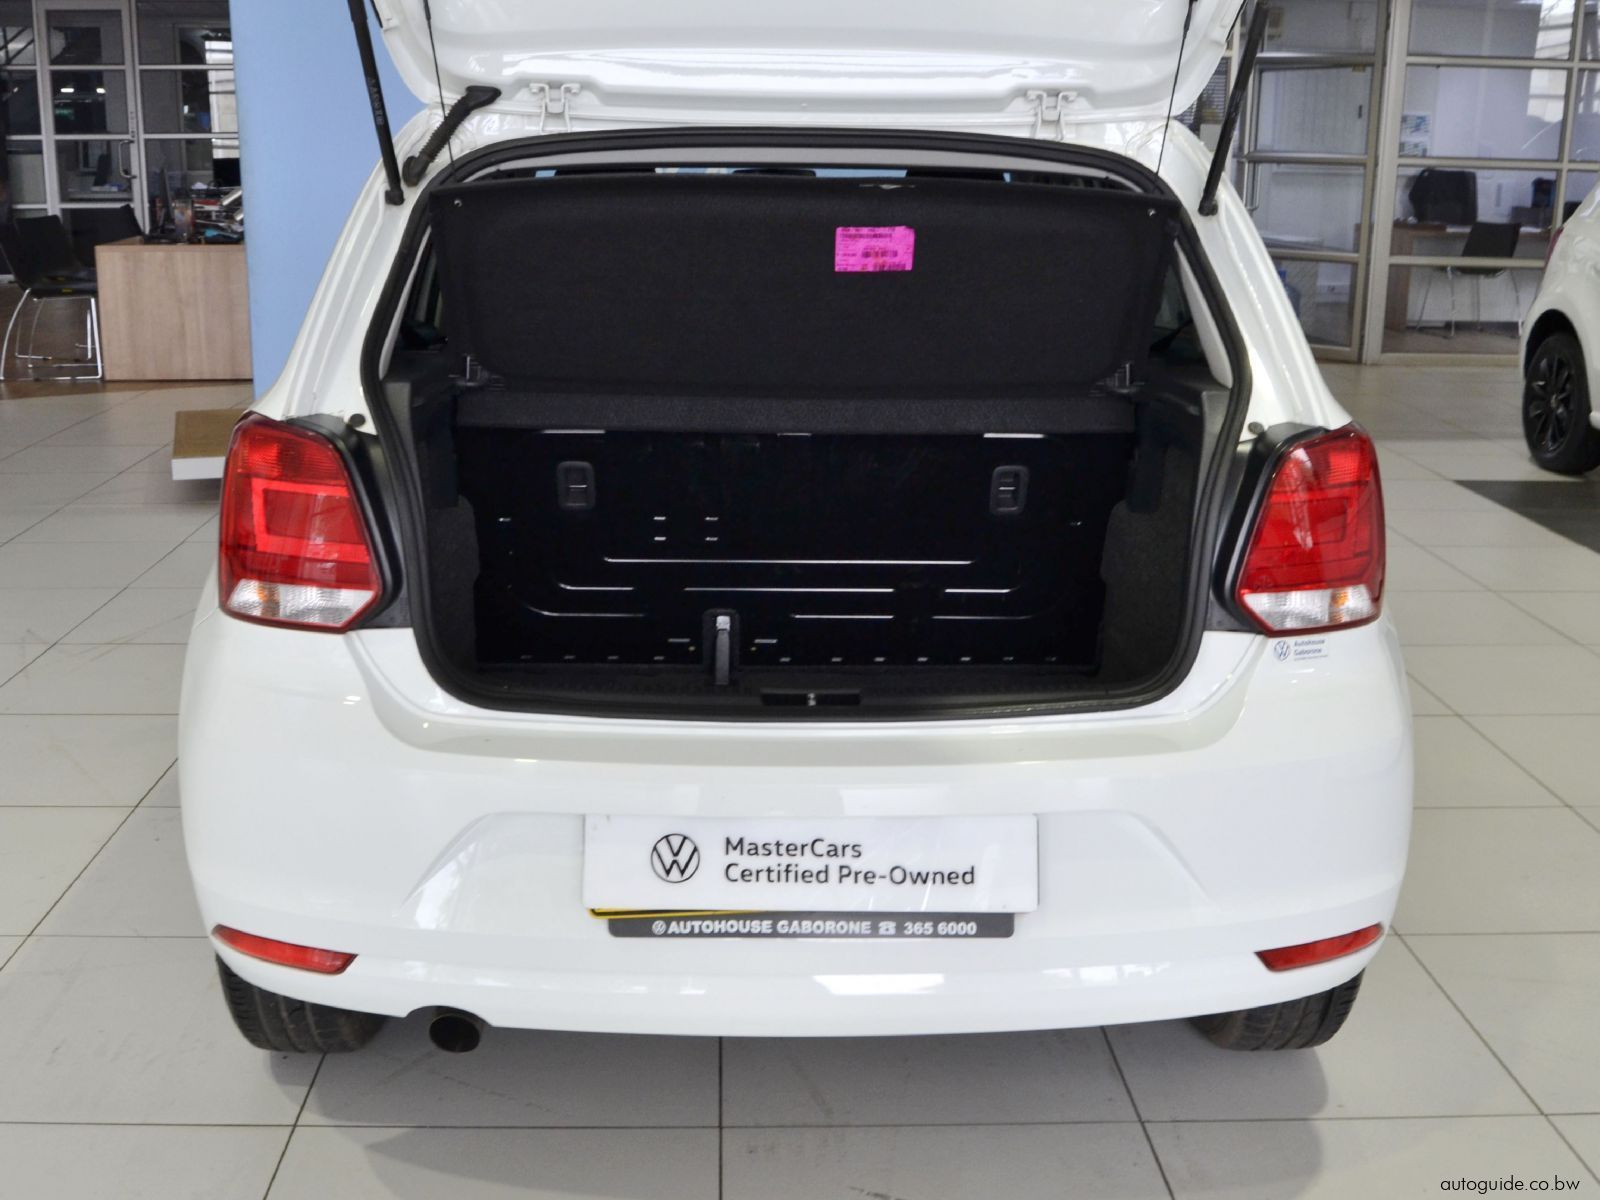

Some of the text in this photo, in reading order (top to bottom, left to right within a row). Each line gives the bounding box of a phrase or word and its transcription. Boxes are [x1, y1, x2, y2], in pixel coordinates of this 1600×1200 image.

[724, 836, 863, 859] MasterCars
[724, 862, 976, 886] Certified Pre-Owned
[667, 920, 978, 936] AUTOHOUSE GABORONE 365 6000
